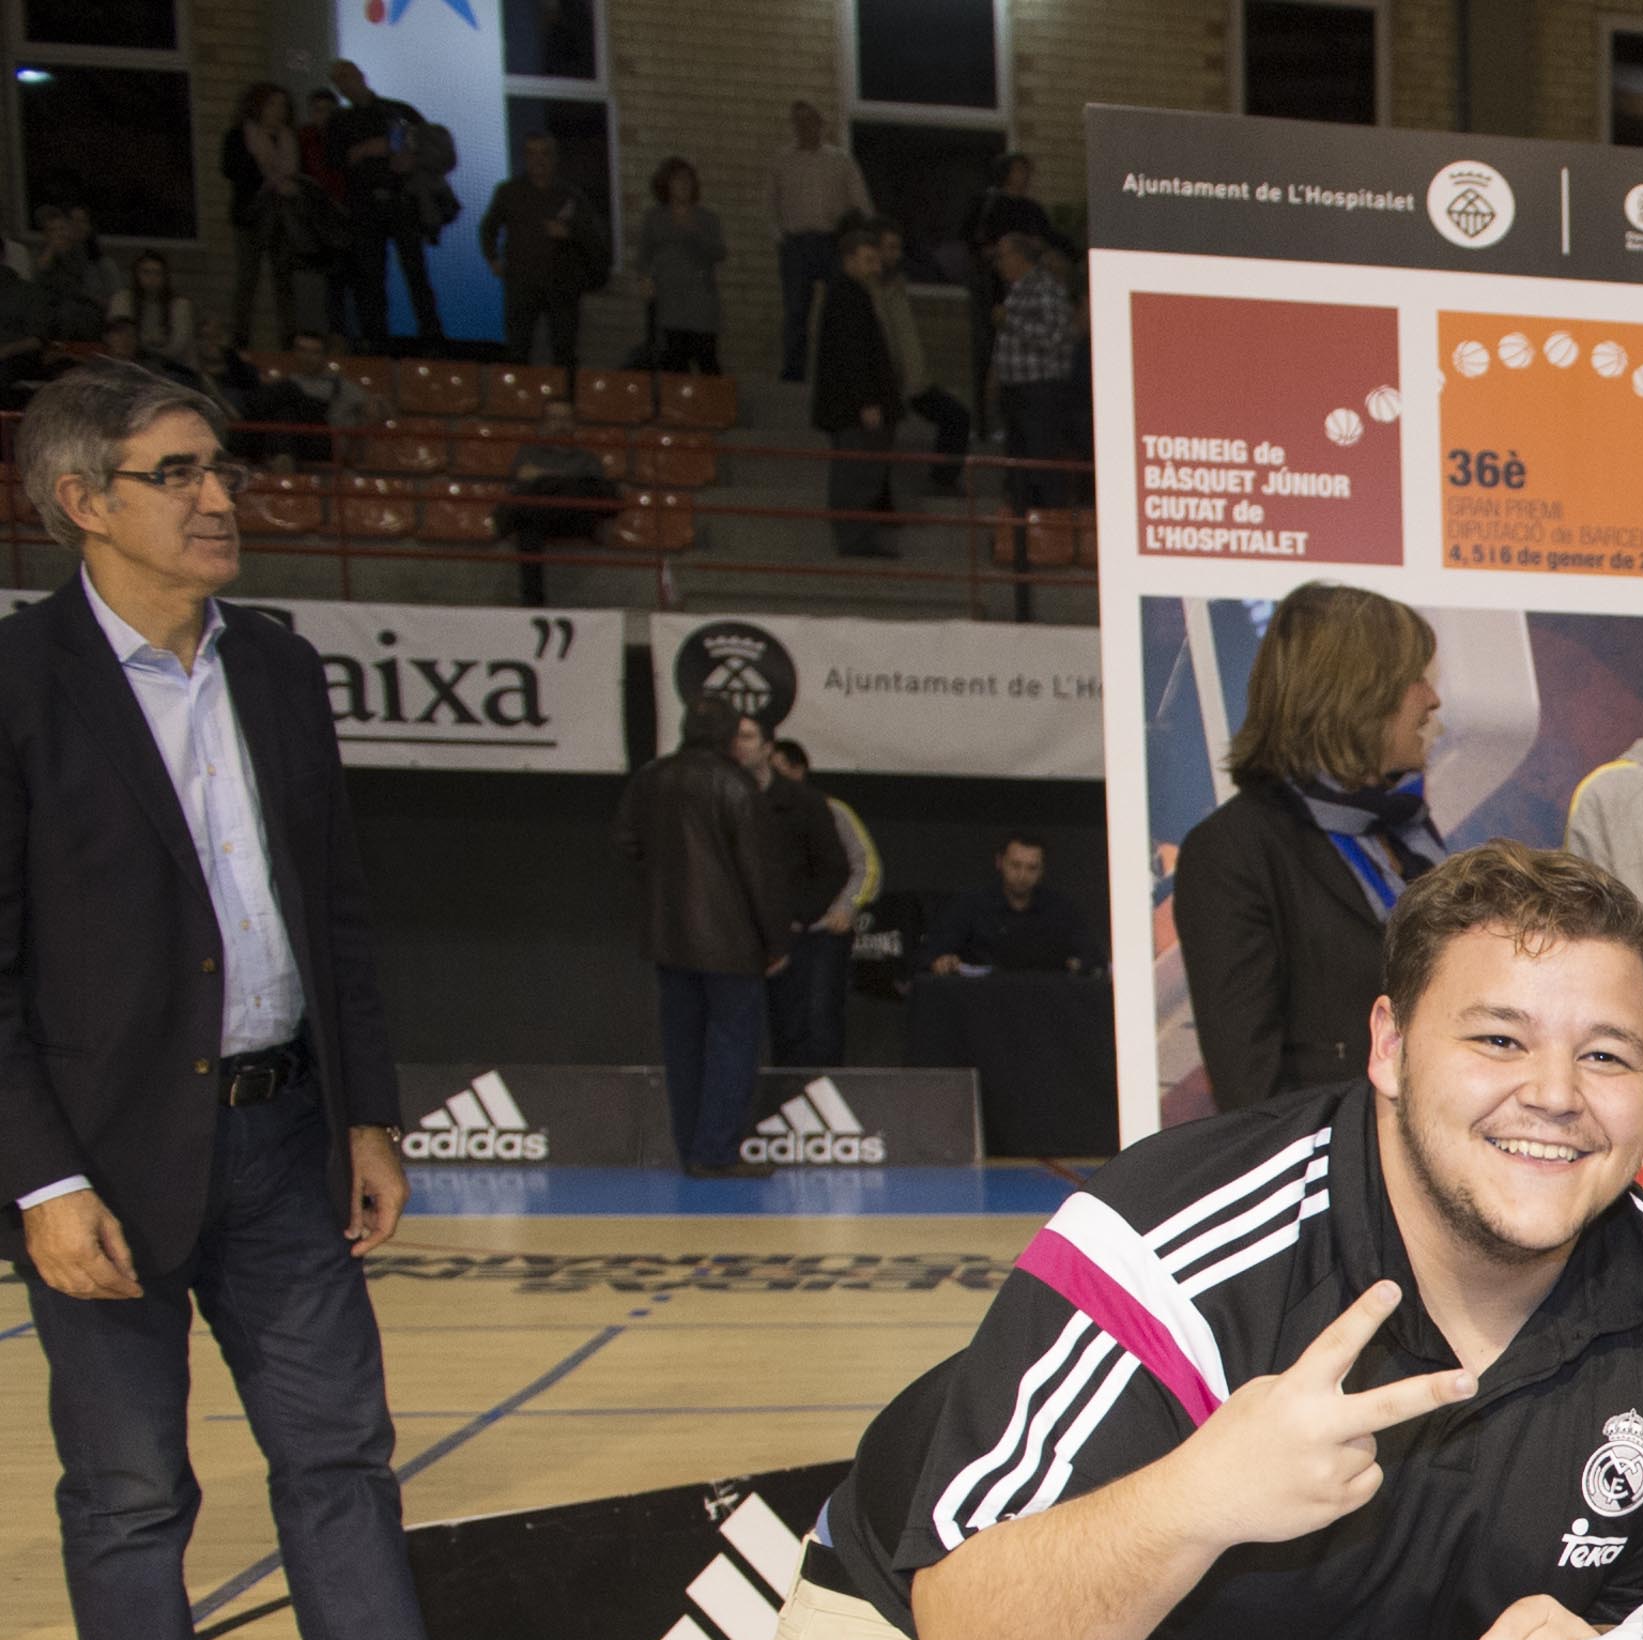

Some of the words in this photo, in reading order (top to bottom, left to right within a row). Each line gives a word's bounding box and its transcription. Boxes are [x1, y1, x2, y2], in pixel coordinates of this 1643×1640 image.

[1122, 173, 1249, 200] Ajuntament
[1255, 181, 1282, 202] de
[1288, 184, 1414, 211] L'Hospitalet
[1142, 434, 1248, 463] TORNEIG
[1253, 441, 1285, 465] de
[1144, 461, 1256, 494] BÀSQUET
[1262, 467, 1351, 498] JÚNIOR
[1448, 448, 1526, 489] 36è
[1144, 495, 1227, 521] CIUTAT
[1232, 499, 1264, 523] de
[1146, 525, 1308, 555] L'HOSPITALET
[1472, 546, 1484, 563] 5
[1517, 547, 1541, 566] de
[1546, 551, 1604, 570] gener
[1610, 550, 1634, 569] de
[824, 666, 998, 699] Ajuntament
[1007, 673, 1043, 699] de
[402, 1130, 549, 1160] adidas
[740, 1132, 886, 1164] adidas
[1557, 1532, 1628, 1569] Teka
